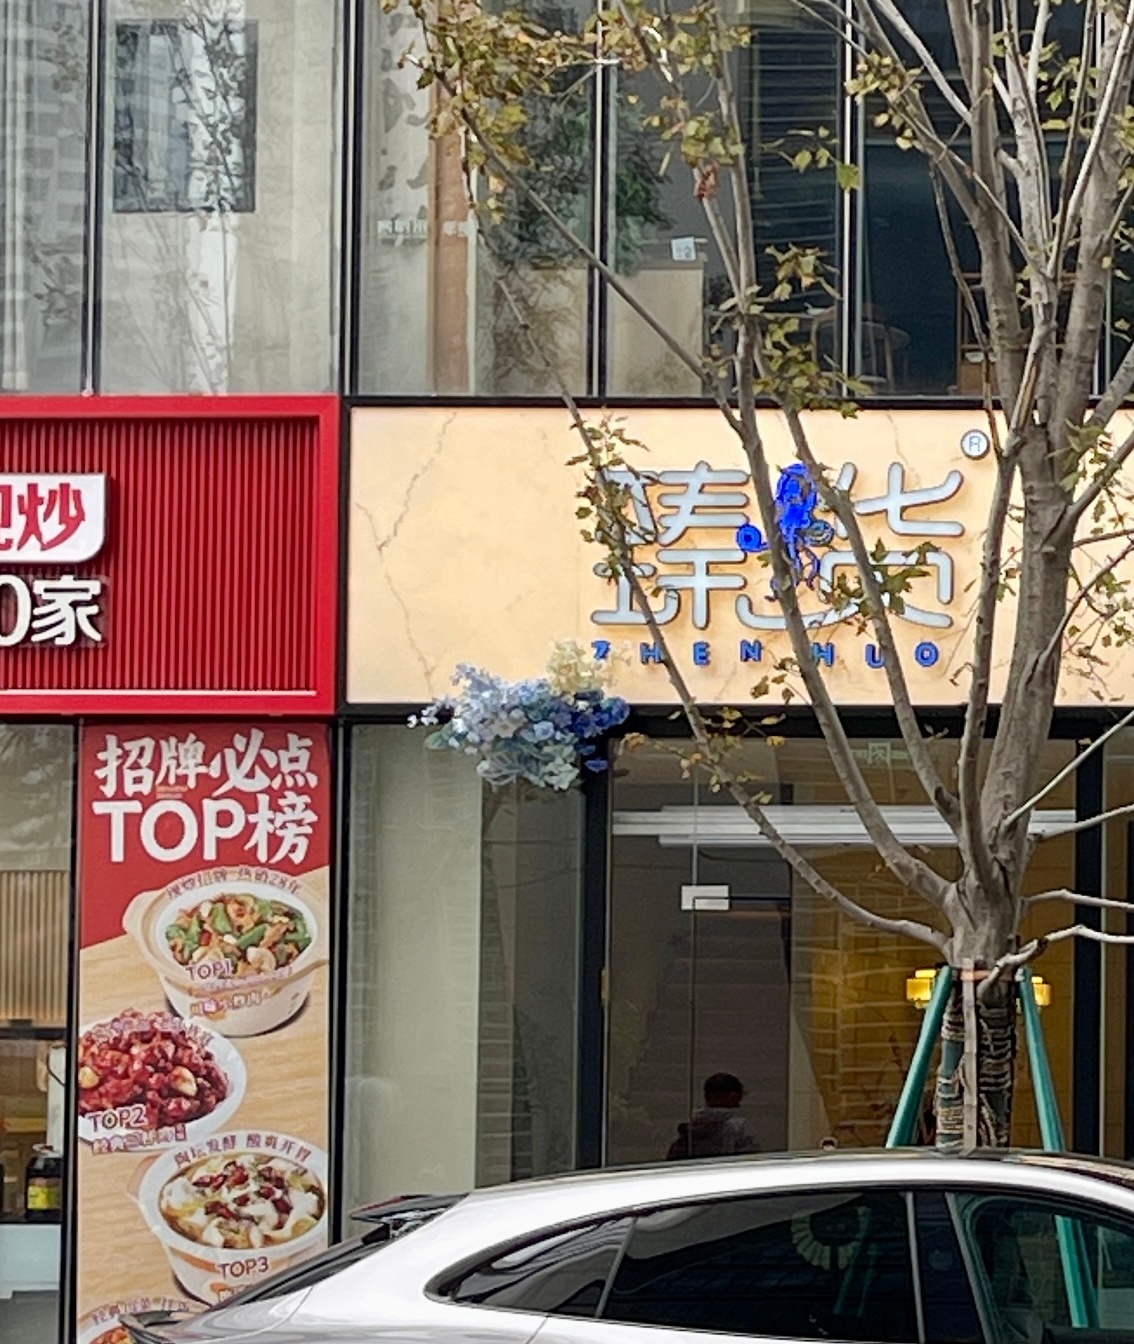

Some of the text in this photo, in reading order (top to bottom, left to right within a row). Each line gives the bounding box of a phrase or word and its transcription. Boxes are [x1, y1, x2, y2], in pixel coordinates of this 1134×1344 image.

[0, 483, 86, 552] 炒
[808, 640, 941, 668] HUO
[95, 728, 318, 798] 招牌必点
[92, 791, 318, 864] TOP榜
[88, 1106, 146, 1132] TOP2
[218, 1256, 269, 1278] TOP3
